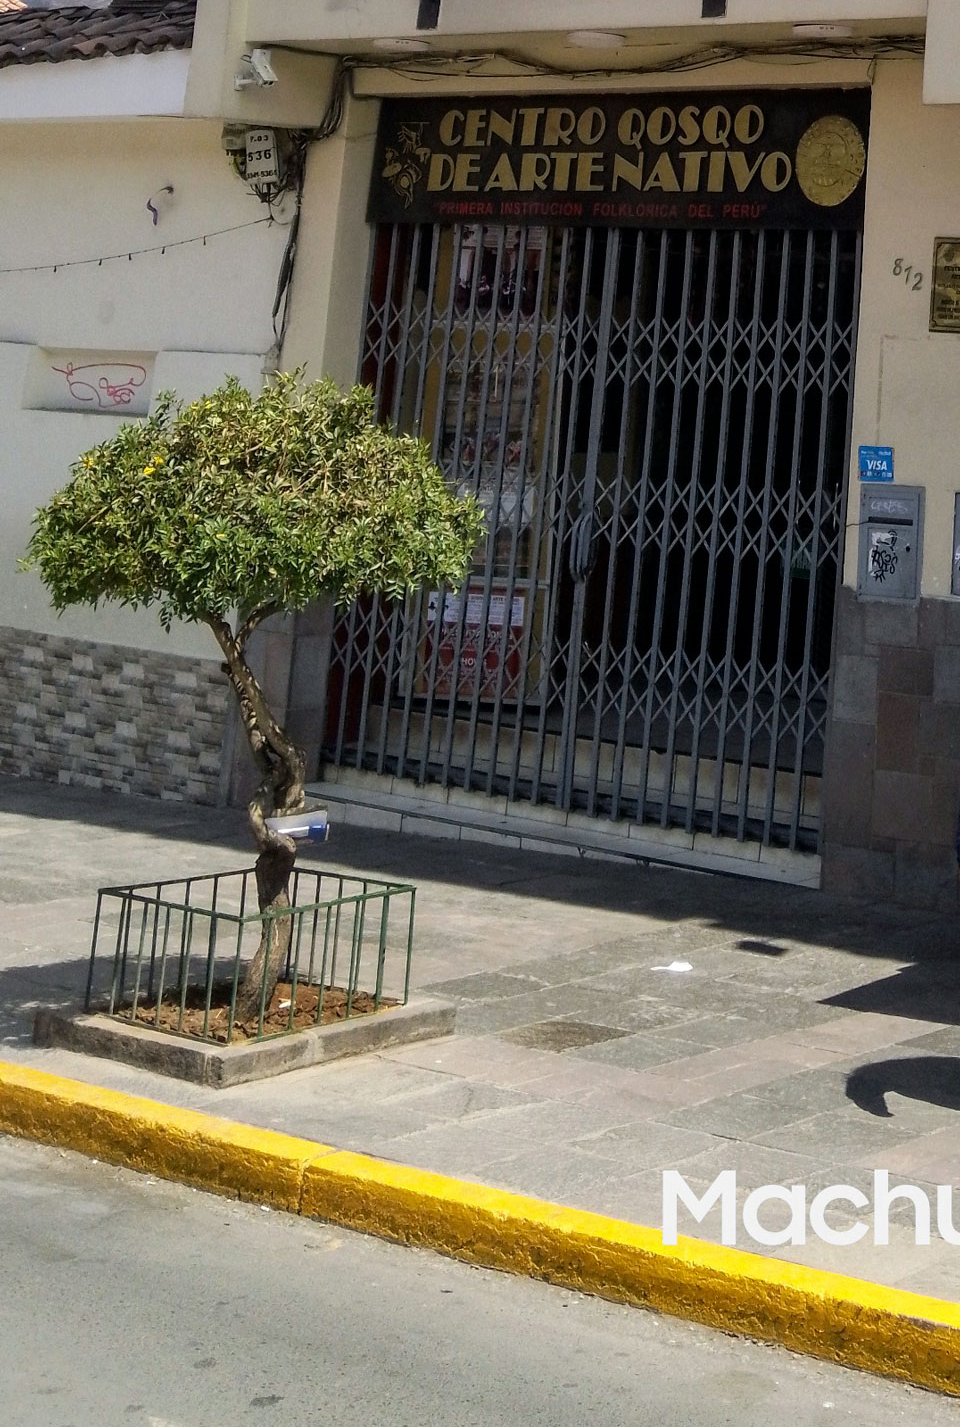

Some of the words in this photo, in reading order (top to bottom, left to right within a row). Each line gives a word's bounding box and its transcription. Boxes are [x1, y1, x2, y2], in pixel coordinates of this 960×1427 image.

[439, 106, 606, 147] CENTRO
[617, 104, 765, 150] QOSQO
[248, 149, 272, 162] 536
[427, 153, 481, 192] DE
[483, 152, 605, 192] ARTE
[611, 150, 793, 193] NATIVO
[688, 203, 714, 218] DEL
[892, 258, 923, 291] 812
[866, 460, 888, 471] VISA
